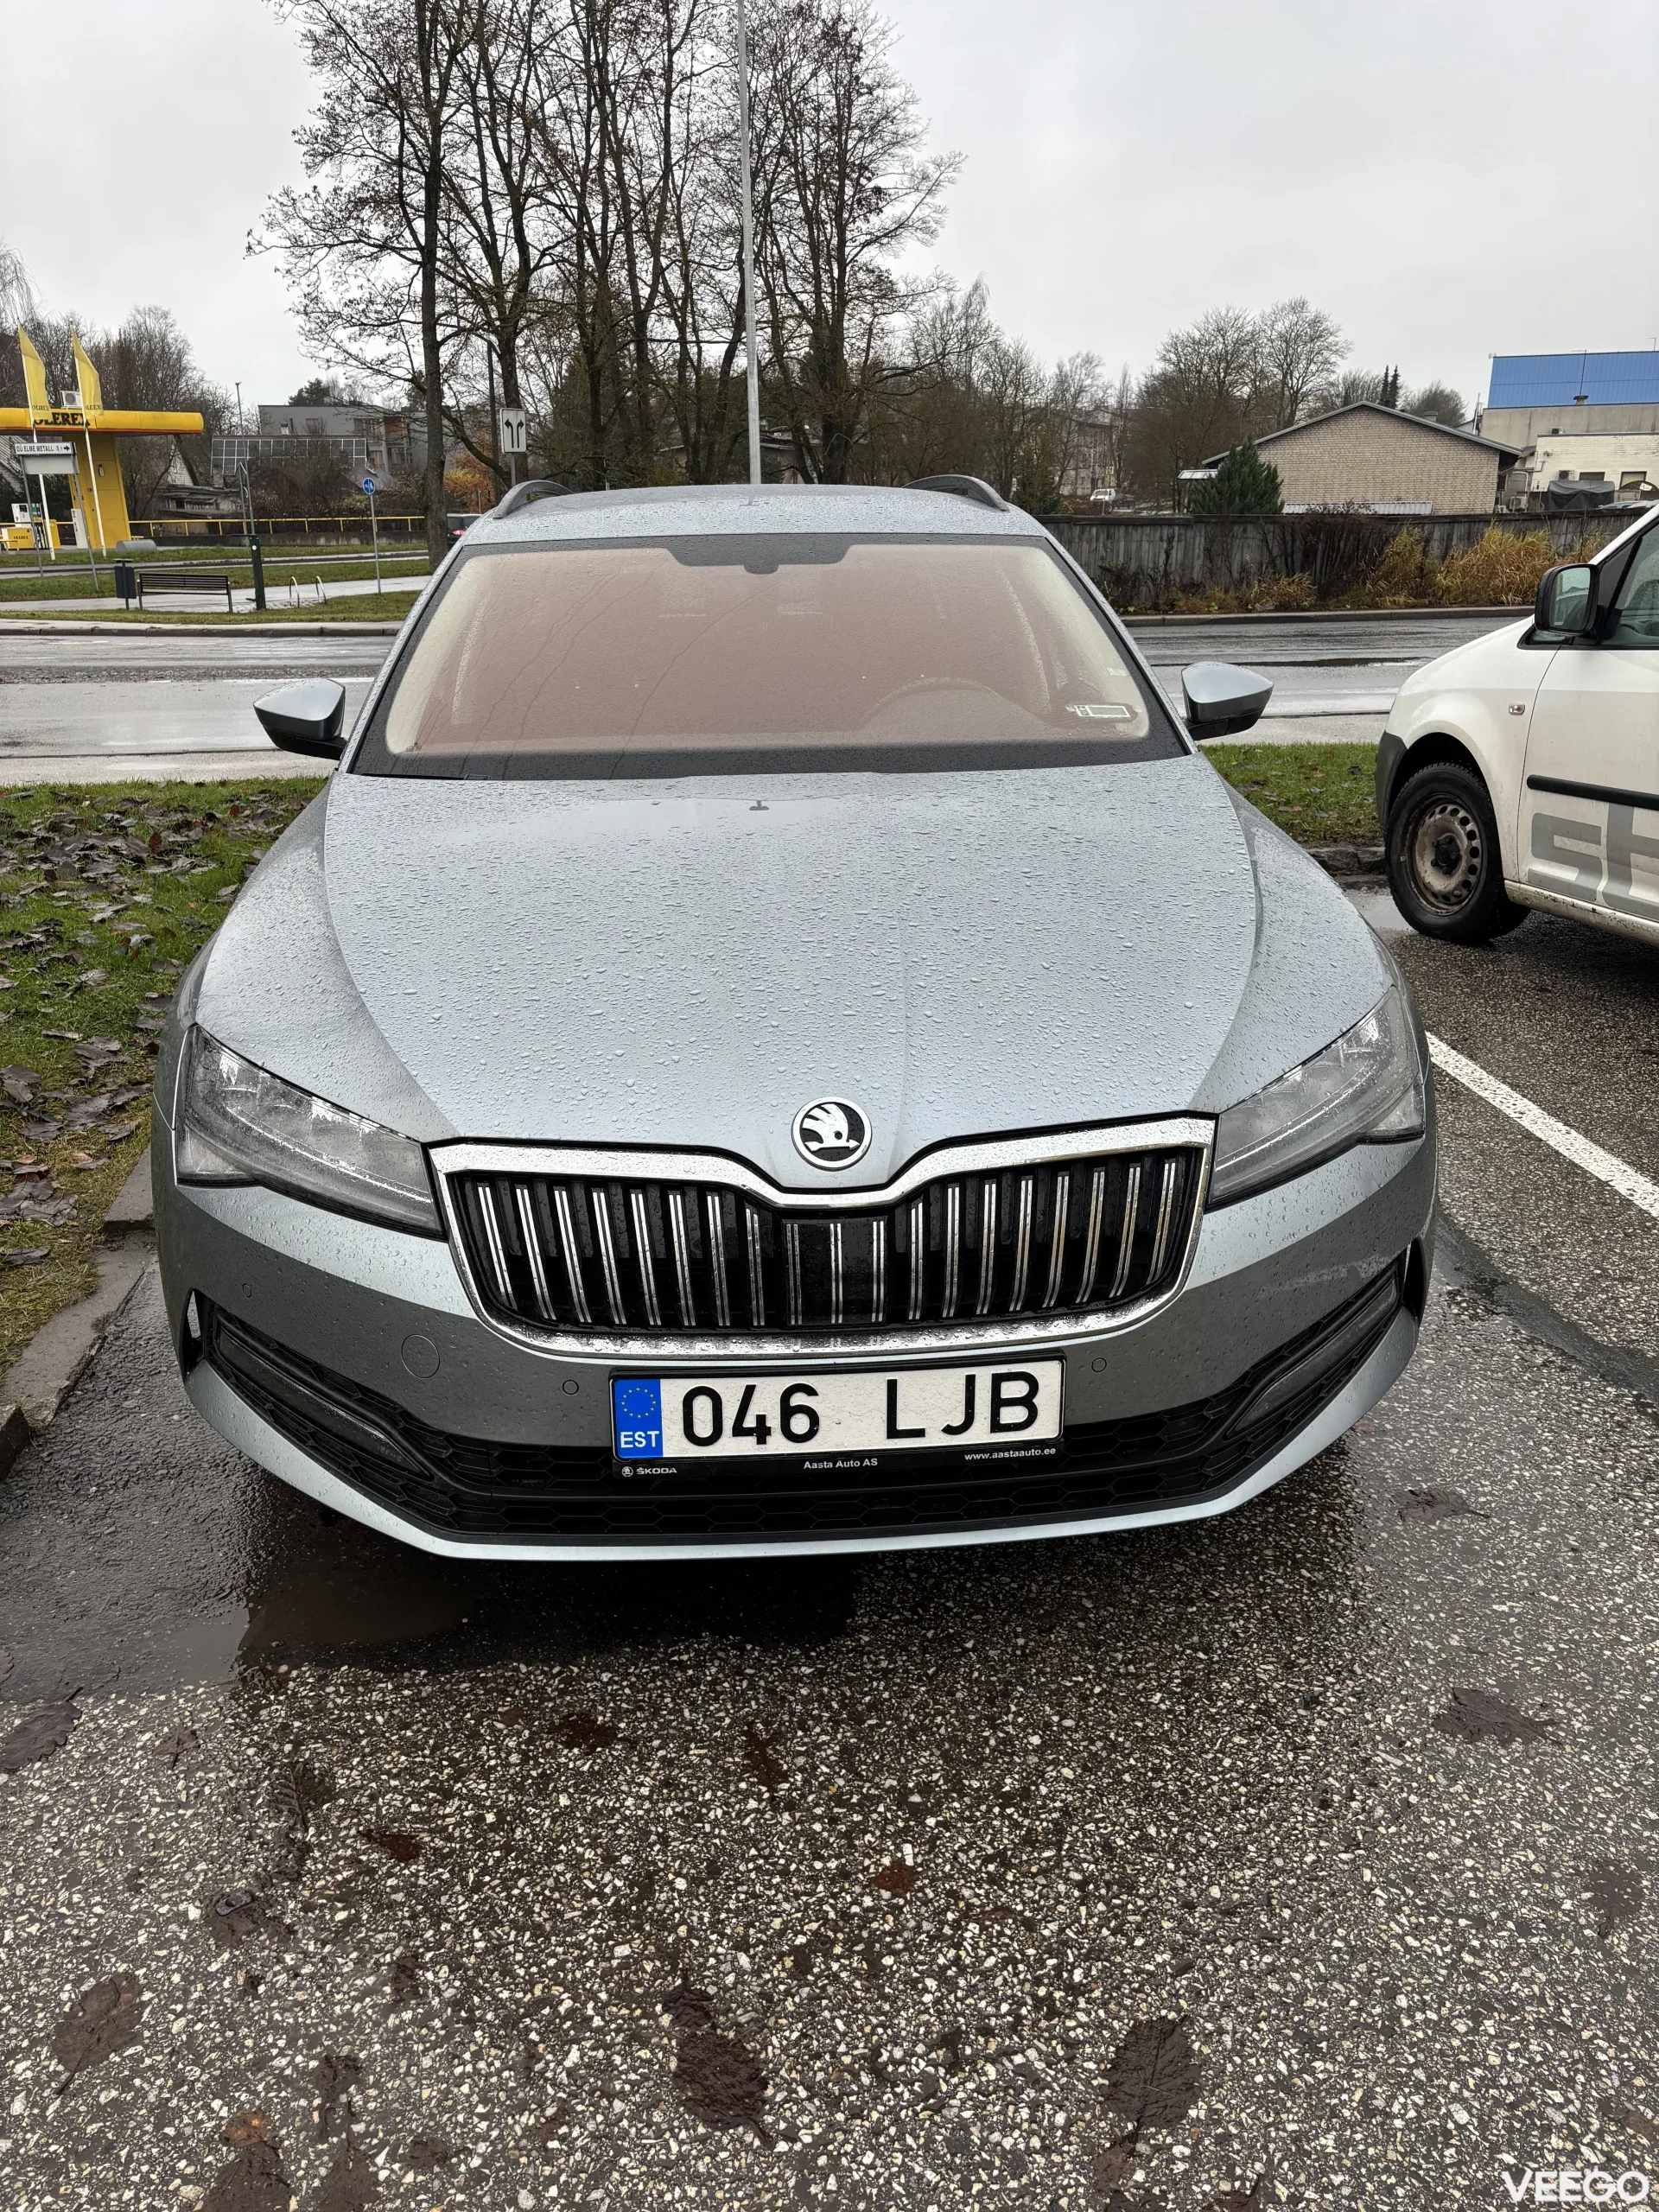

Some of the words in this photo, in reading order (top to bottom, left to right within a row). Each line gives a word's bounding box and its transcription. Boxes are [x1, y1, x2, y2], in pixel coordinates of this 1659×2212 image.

[682, 1382, 820, 1446] 046
[887, 1370, 1039, 1440] LJB
[620, 1430, 659, 1448] EST
[964, 1447, 1057, 1460] www.aastaauto.ee
[636, 1466, 677, 1475] ŠKODA
[804, 1460, 833, 1470] Aasta
[836, 1459, 861, 1468] Auto
[862, 1458, 878, 1467] AS
